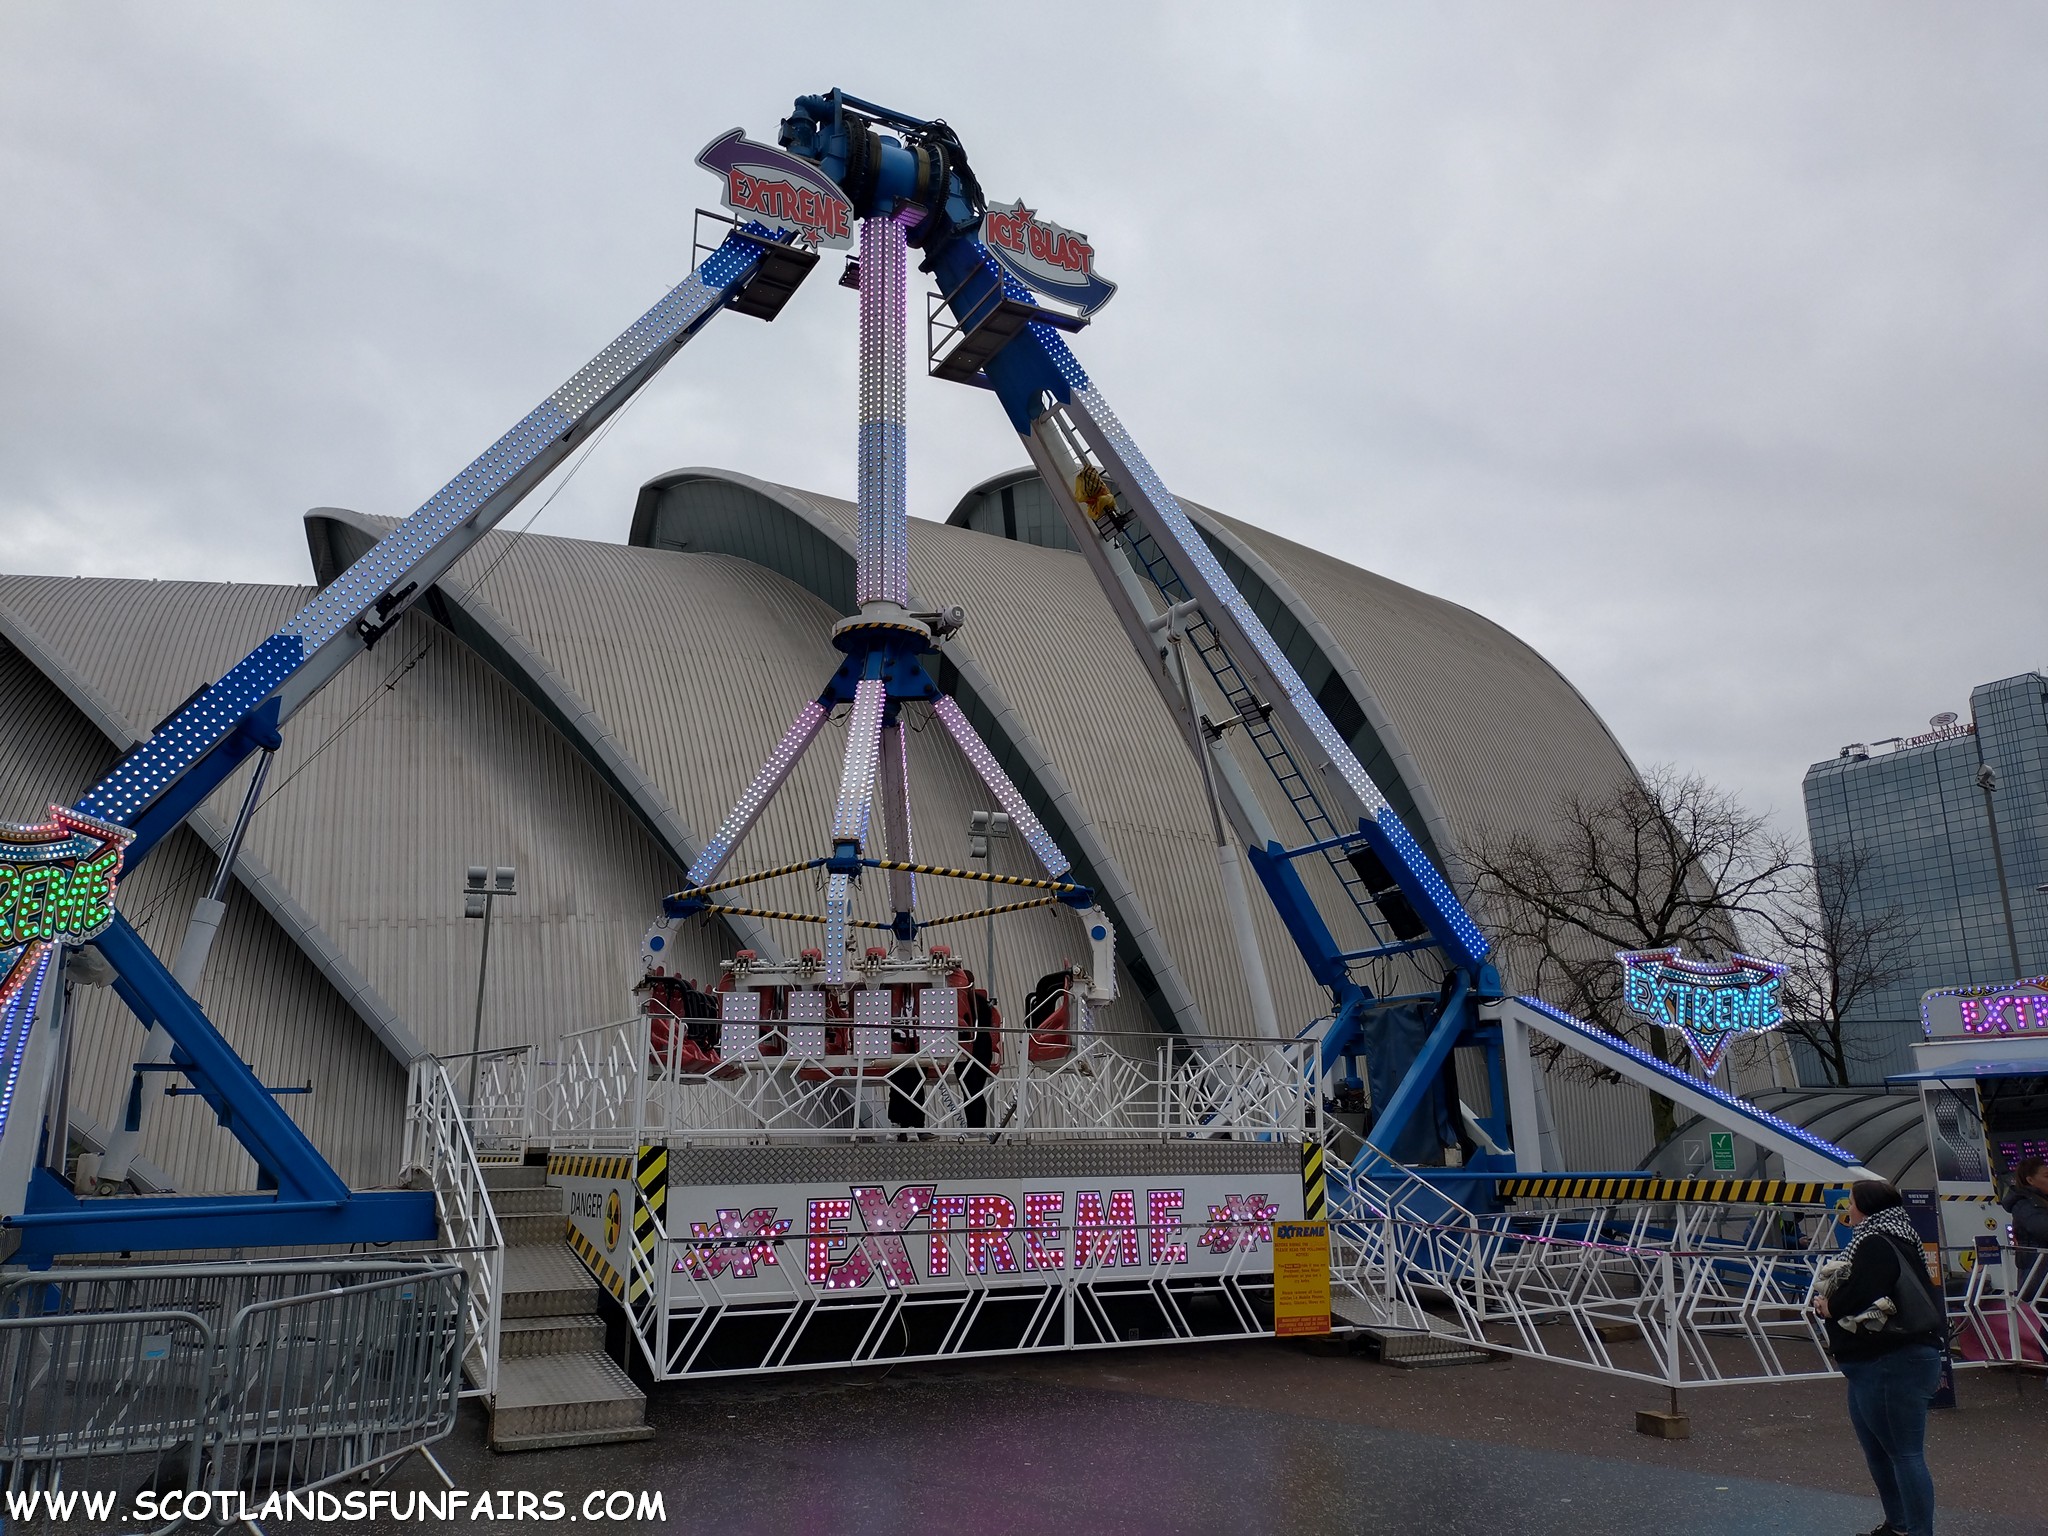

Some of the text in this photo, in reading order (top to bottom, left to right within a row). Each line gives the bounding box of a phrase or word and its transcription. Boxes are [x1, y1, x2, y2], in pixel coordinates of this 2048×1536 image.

[728, 168, 850, 239] EXTREME
[987, 212, 1093, 274] ICE BLAST
[1628, 966, 1780, 1031] EXTREME
[570, 1191, 603, 1219] DANGER
[1277, 1225, 1326, 1239] EXTREME
[807, 1184, 1187, 1290] EXTREME
